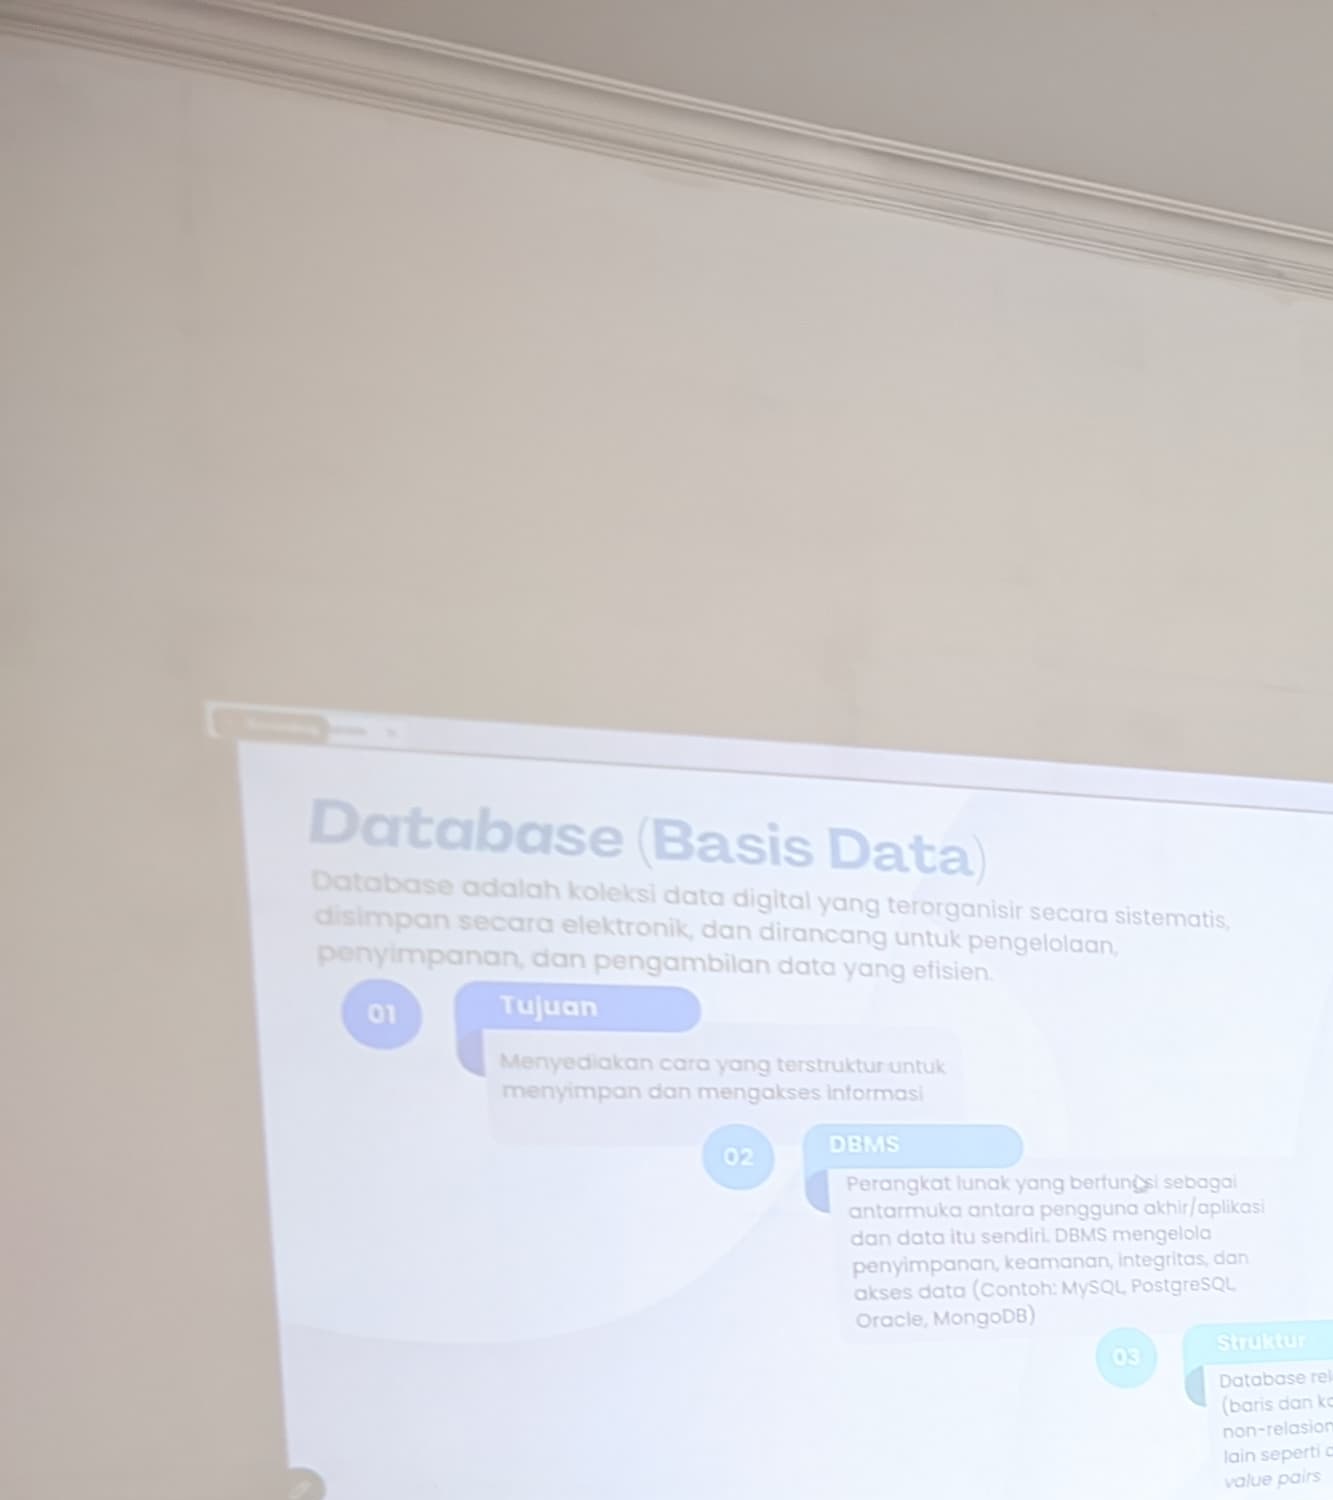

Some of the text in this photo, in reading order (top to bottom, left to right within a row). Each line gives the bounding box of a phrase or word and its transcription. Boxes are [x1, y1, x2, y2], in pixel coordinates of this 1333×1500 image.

[308, 797, 987, 886] Database (Basis Data)
[312, 869, 1230, 931] Database adalah koleksi data digital yang terorganisir secara sistematis,
[315, 905, 1119, 958] disimpan secara elektronik, dan dirancang untuk pengelolaan,
[318, 942, 994, 984] penyimpanan, dan pengambilan data yang efisien.
[367, 1002, 397, 1025] 01
[499, 995, 600, 1021] Tujuan
[500, 1052, 946, 1078] Menyediakan cara yang terstruktur untuk
[503, 1082, 924, 1107] menyimpan dan mengakses informasi
[722, 1147, 754, 1168] 02
[828, 1134, 901, 1155] DBMS
[846, 1173, 952, 1198] Perangkat
[956, 1173, 1011, 1193] lunak
[1015, 1176, 1065, 1197] yang
[1164, 1173, 1237, 1195] sebagai
[848, 1196, 1265, 1222] antarmuka antara pengguna akhir/aplikasi
[850, 1228, 893, 1249] dan
[897, 1227, 945, 1248] data
[949, 1226, 976, 1246] itu
[1056, 1225, 1107, 1245] DBMS
[1112, 1223, 1212, 1247] mengelola
[852, 1254, 1000, 1280] penyimpanan,
[1004, 1250, 1112, 1271] keamanan,
[1212, 1249, 1249, 1265] dan
[853, 1281, 913, 1303] akses
[918, 1280, 966, 1301] data
[971, 1277, 1057, 1302] (Contoh:
[856, 1304, 1036, 1330] Oracle, MongoDB)
[1216, 1331, 1307, 1353] Struktur
[1111, 1347, 1140, 1368] 03
[1220, 1367, 1306, 1389] Database
[1221, 1394, 1273, 1418] (baris
[1279, 1392, 1313, 1412] dan
[1223, 1446, 1257, 1466] lain
[1260, 1442, 1321, 1466] seperti
[1224, 1468, 1321, 1491] value pairs
